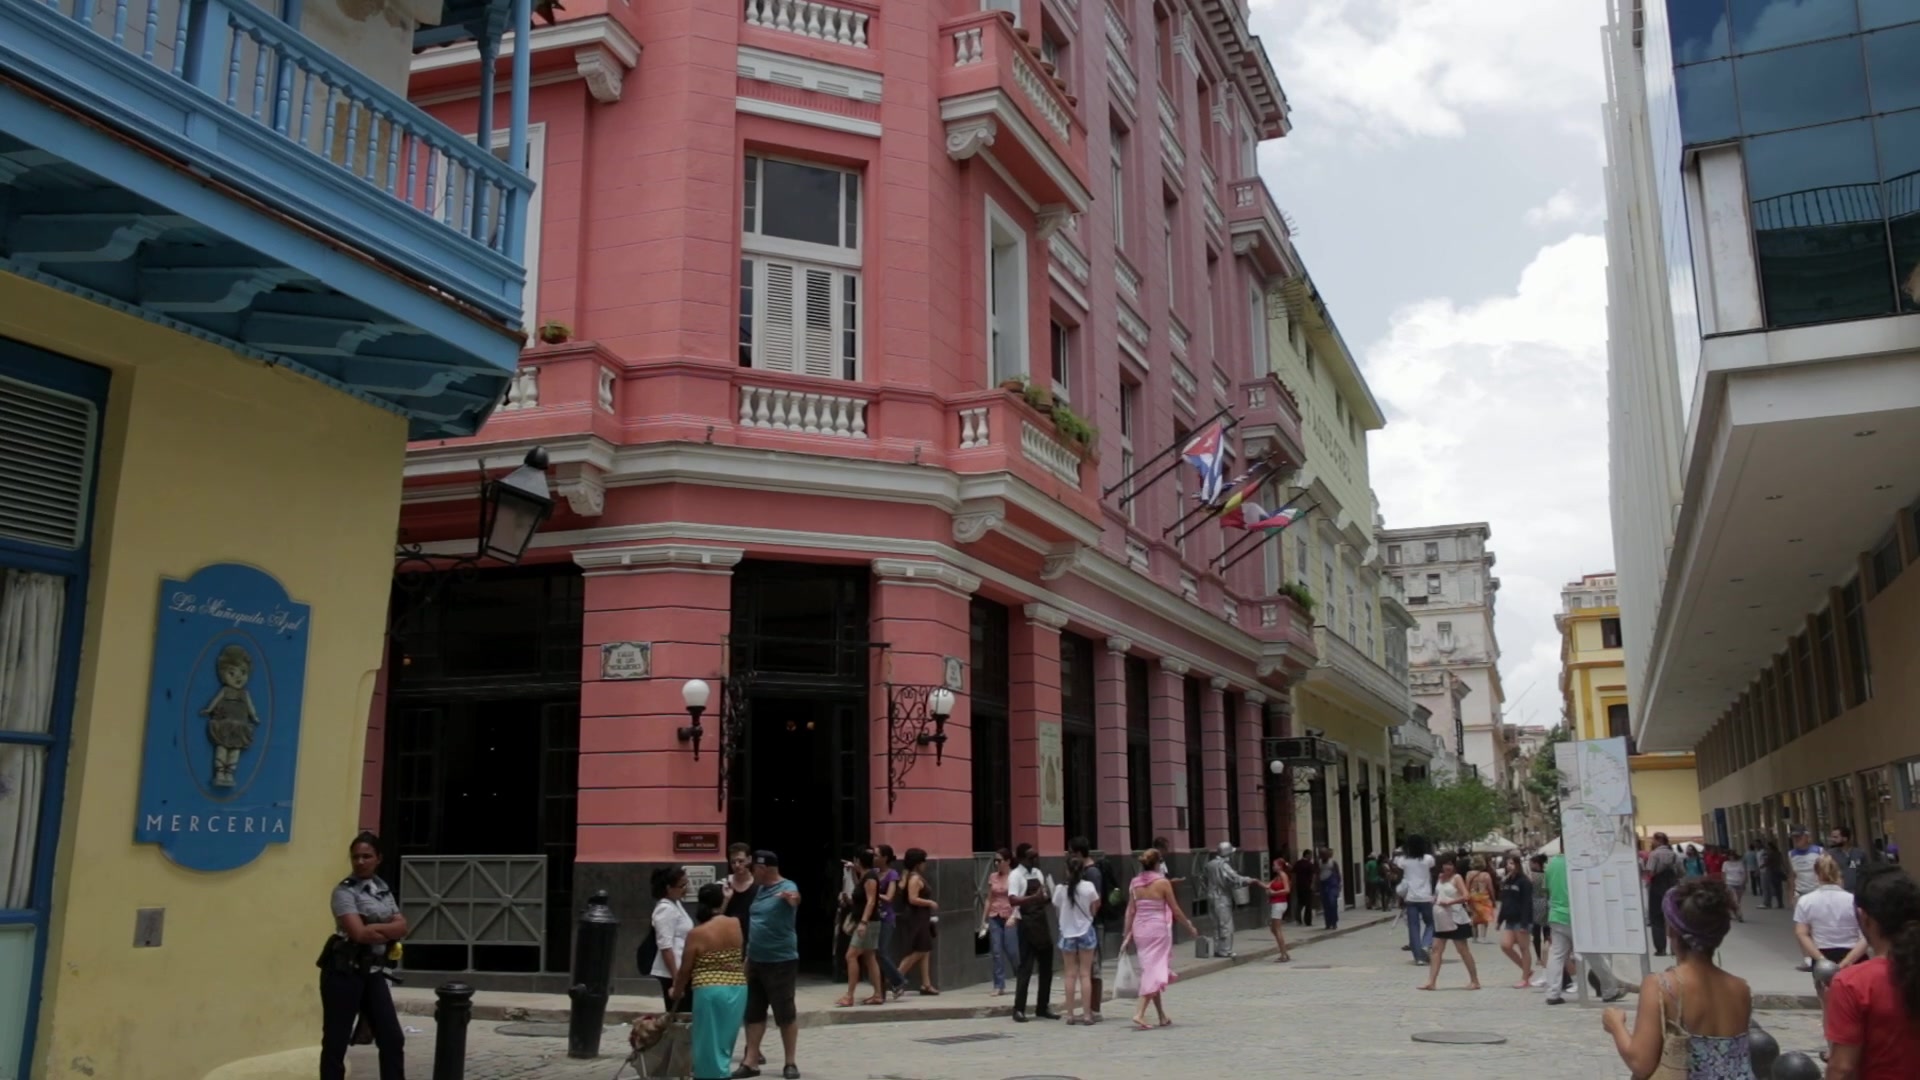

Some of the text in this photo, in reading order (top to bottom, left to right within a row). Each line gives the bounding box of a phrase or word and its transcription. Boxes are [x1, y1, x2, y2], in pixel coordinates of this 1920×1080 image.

[168, 591, 197, 614] La
[198, 597, 265, 627] Muñequita
[146, 814, 285, 833] MERCERIA
